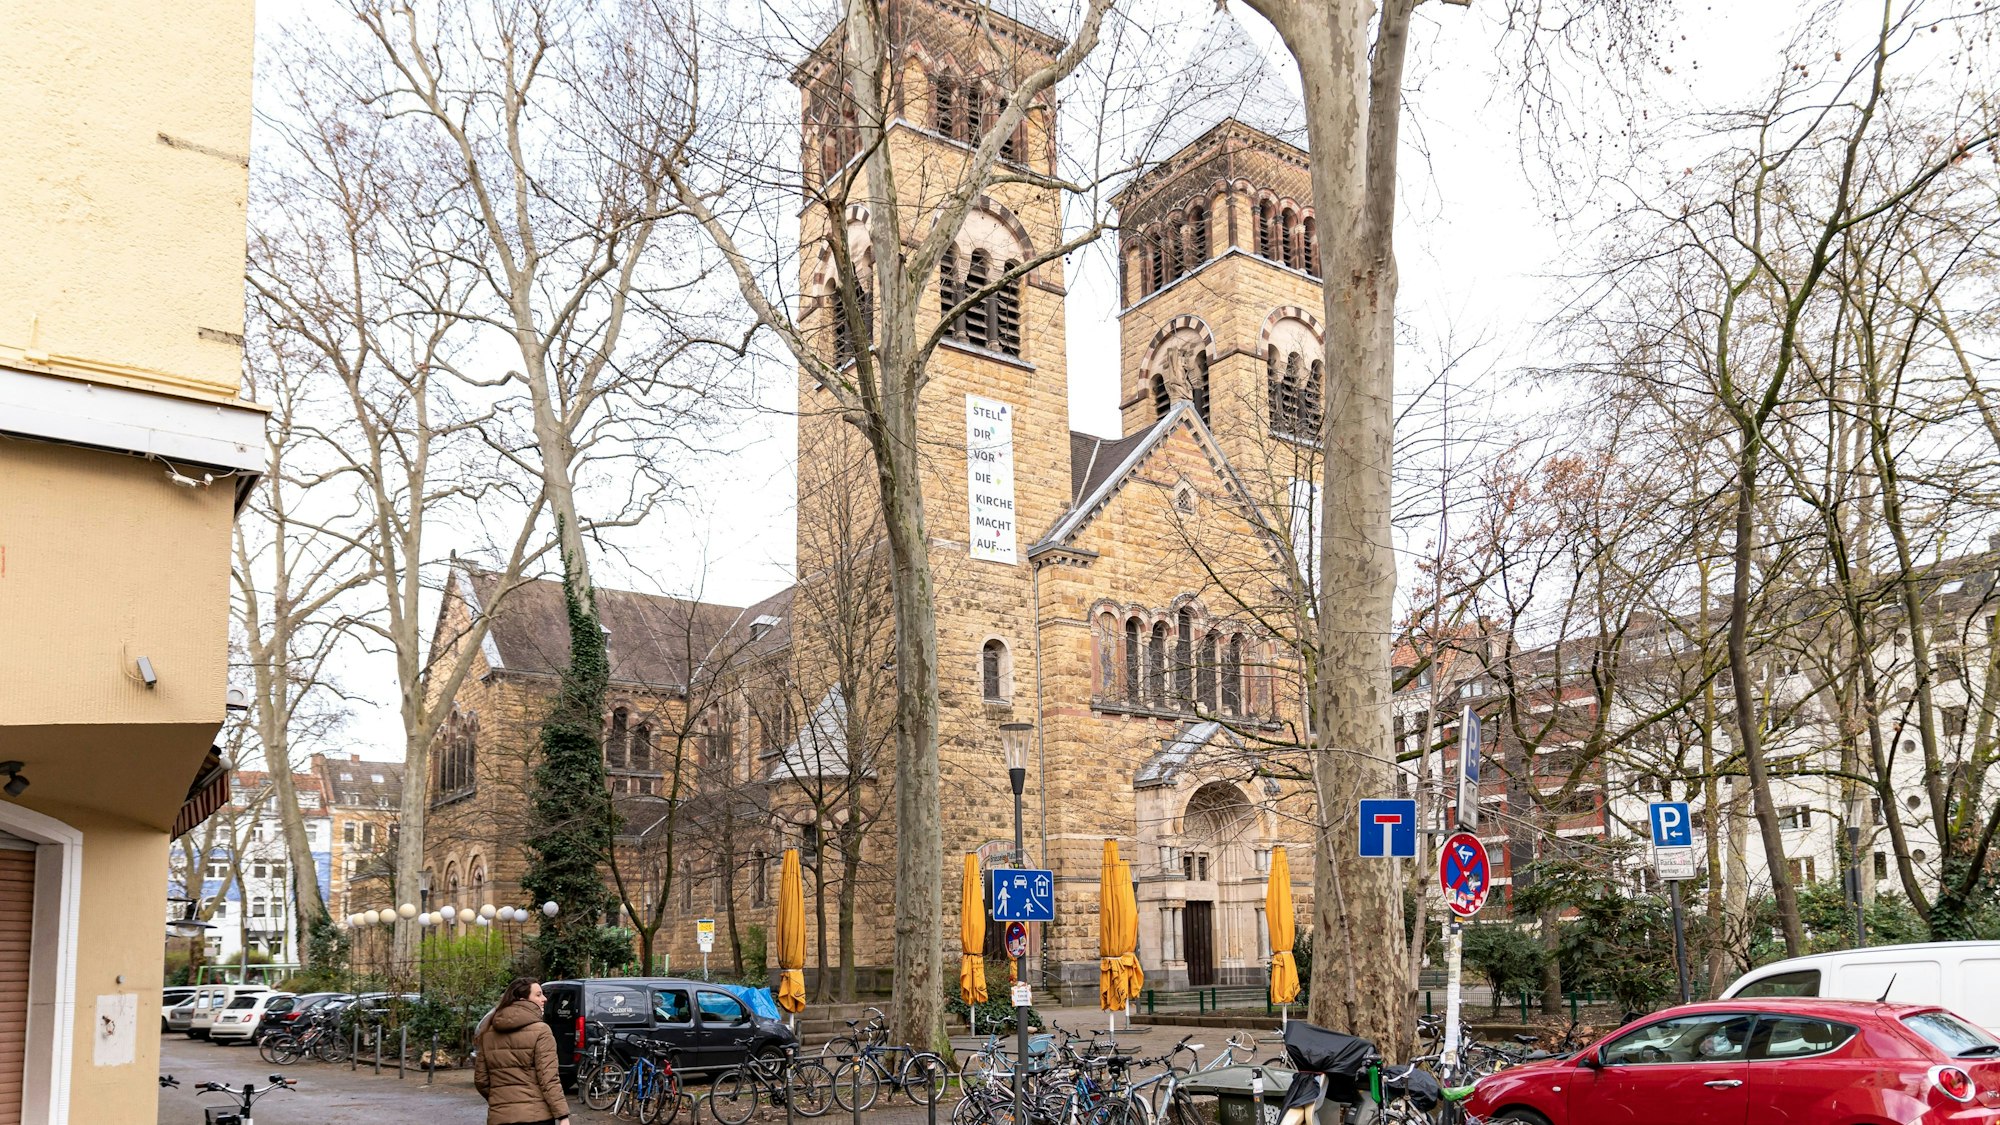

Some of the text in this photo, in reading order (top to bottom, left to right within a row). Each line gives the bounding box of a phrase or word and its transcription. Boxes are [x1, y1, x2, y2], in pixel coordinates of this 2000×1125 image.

[973, 406, 1003, 421] STELL
[974, 428, 991, 440] DIR
[974, 449, 995, 463] VOR
[975, 472, 992, 484] DIE
[976, 494, 1013, 510] KIRCHE
[976, 516, 1011, 531] MACHT
[1659, 806, 1681, 840] P
